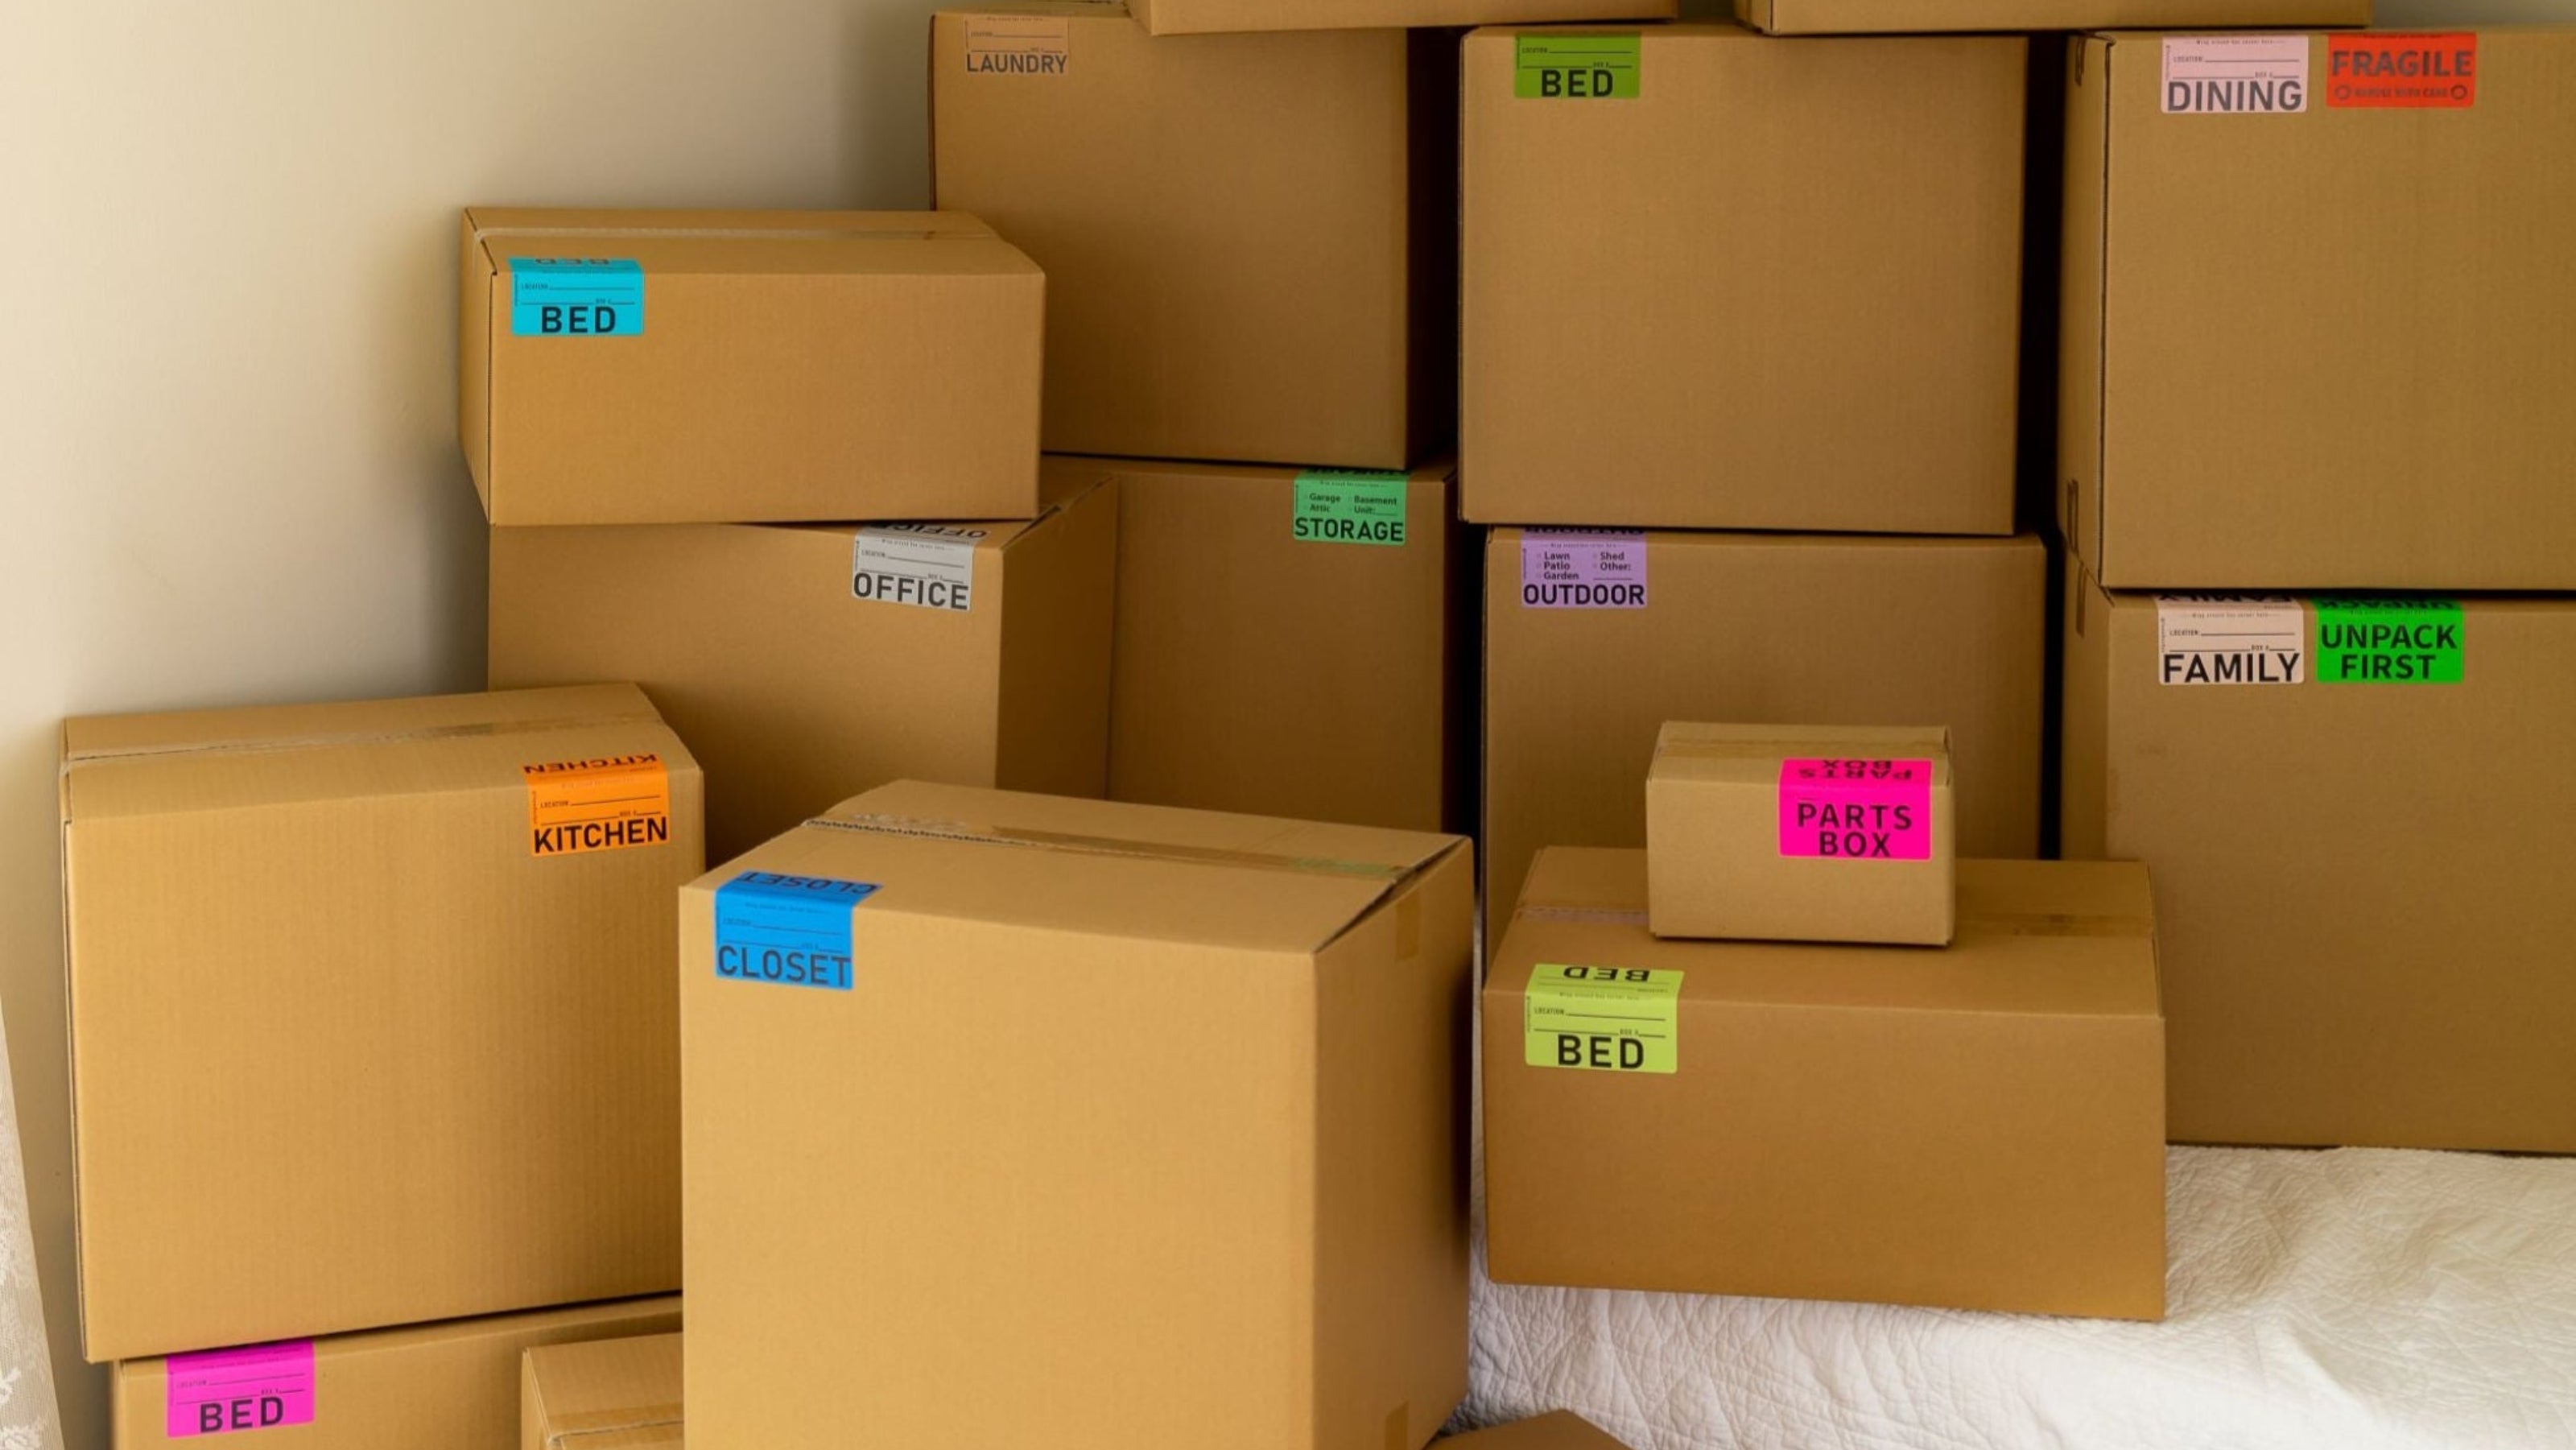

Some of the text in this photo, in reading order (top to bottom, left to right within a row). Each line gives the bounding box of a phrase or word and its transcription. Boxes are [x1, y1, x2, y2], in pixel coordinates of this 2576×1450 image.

[967, 54, 1067, 73] LAUNDRY
[2331, 50, 2472, 76] FRAGILE
[1542, 69, 1613, 97] BED
[2168, 80, 2302, 111] DINING
[541, 306, 616, 333] BED
[1309, 493, 1340, 502] Garage
[1310, 504, 1330, 512] Attic
[1354, 495, 1397, 505] Basement
[1295, 517, 1404, 542] STORAGE
[1544, 551, 1571, 560] Lawn
[1544, 561, 1571, 570] Patio
[1600, 551, 1624, 560] Shed
[1600, 562, 1631, 571] Other:
[1544, 571, 1579, 580] Garden
[853, 572, 969, 610] OFFICE
[1523, 584, 1645, 605] OUTDOOR
[2322, 624, 2457, 649] UNPACK
[2164, 653, 2300, 683] FAMILY
[2341, 655, 2436, 680] FIRST
[523, 754, 657, 774] KITCHEN
[1798, 769, 1912, 779] PARTS
[1798, 803, 1912, 830] PARTS
[534, 816, 667, 853] KITCHEN
[1819, 831, 1891, 857] BOX
[737, 872, 879, 894] CLOSET
[718, 945, 852, 988] CLOSET
[1563, 966, 1651, 982] BED
[1558, 1034, 1644, 1069] BED
[200, 1396, 283, 1433] BED
